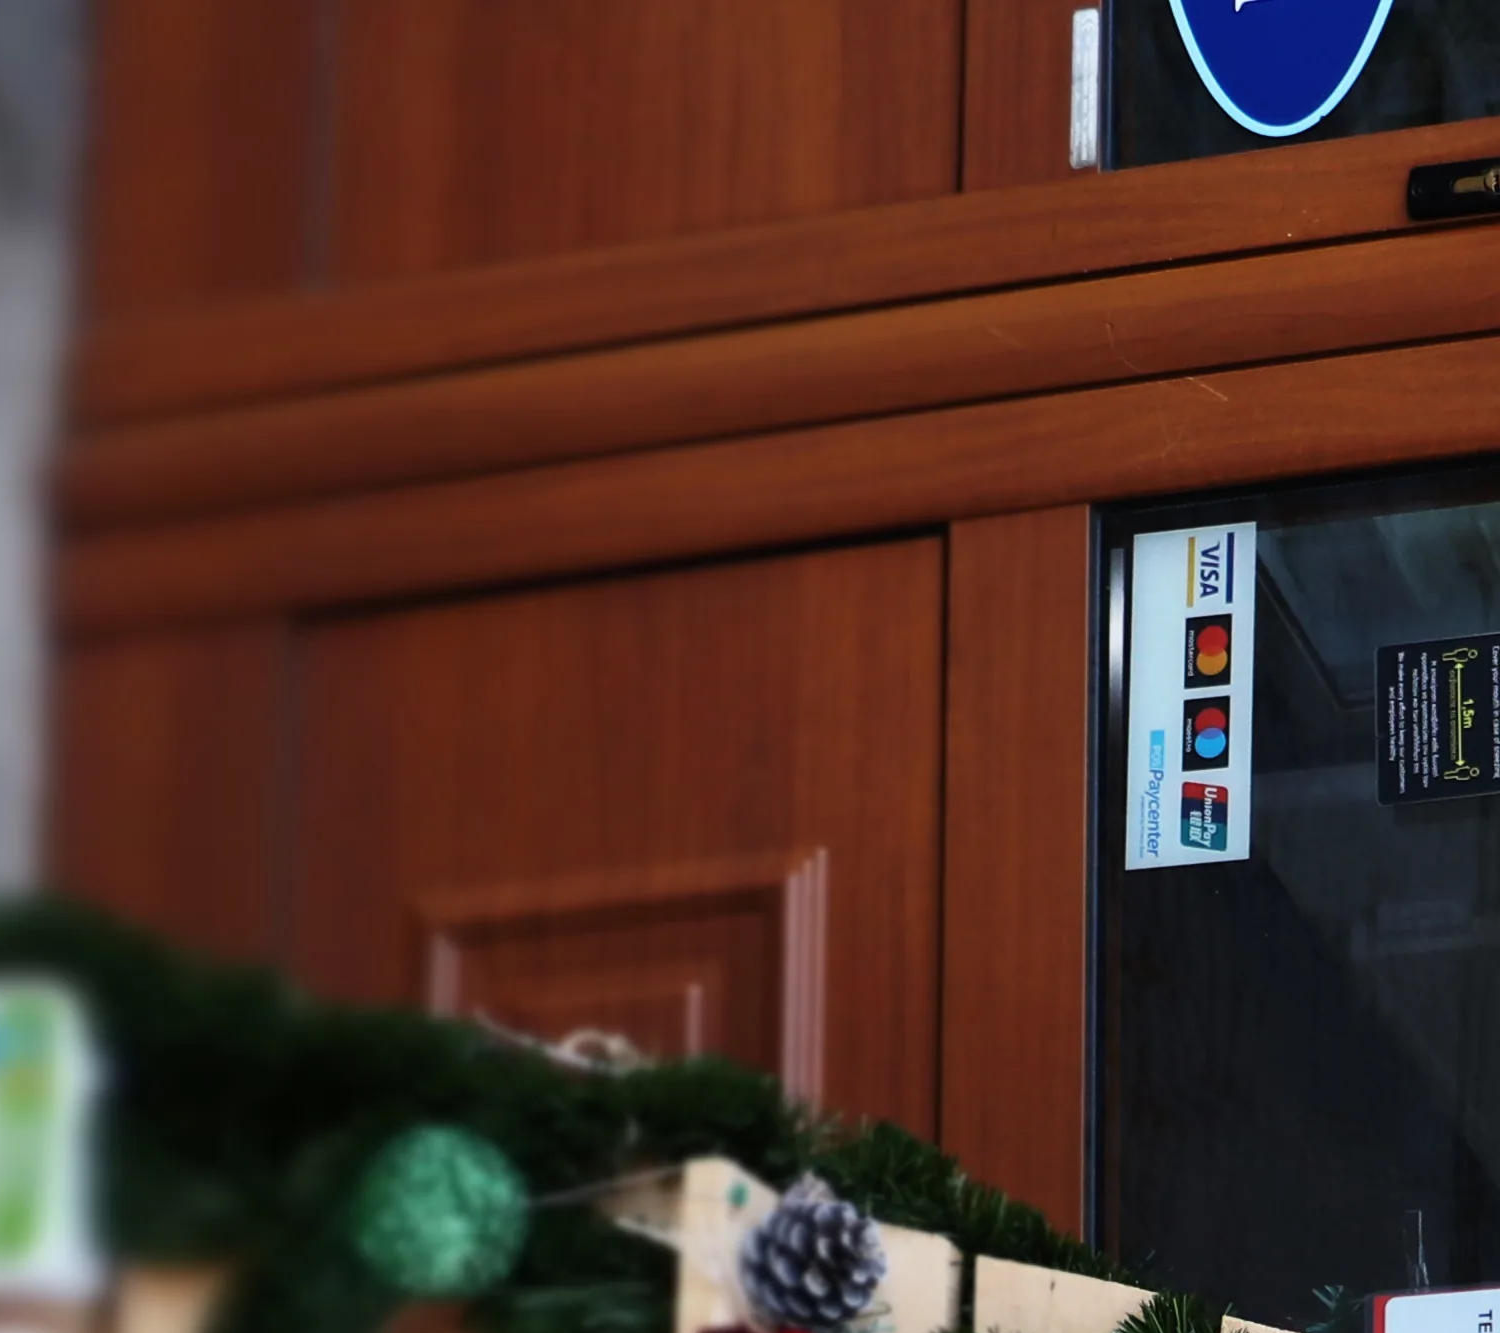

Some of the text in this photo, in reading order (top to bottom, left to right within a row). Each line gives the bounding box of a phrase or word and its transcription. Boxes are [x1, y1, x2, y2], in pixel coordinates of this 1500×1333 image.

[1199, 541, 1220, 598] VISA
[1187, 630, 1195, 677] mastercard
[1185, 718, 1193, 752] maestro
[1461, 698, 1475, 729] 1,5m
[1144, 769, 1164, 858] Paycenter
[1198, 787, 1218, 847] UnionPay
